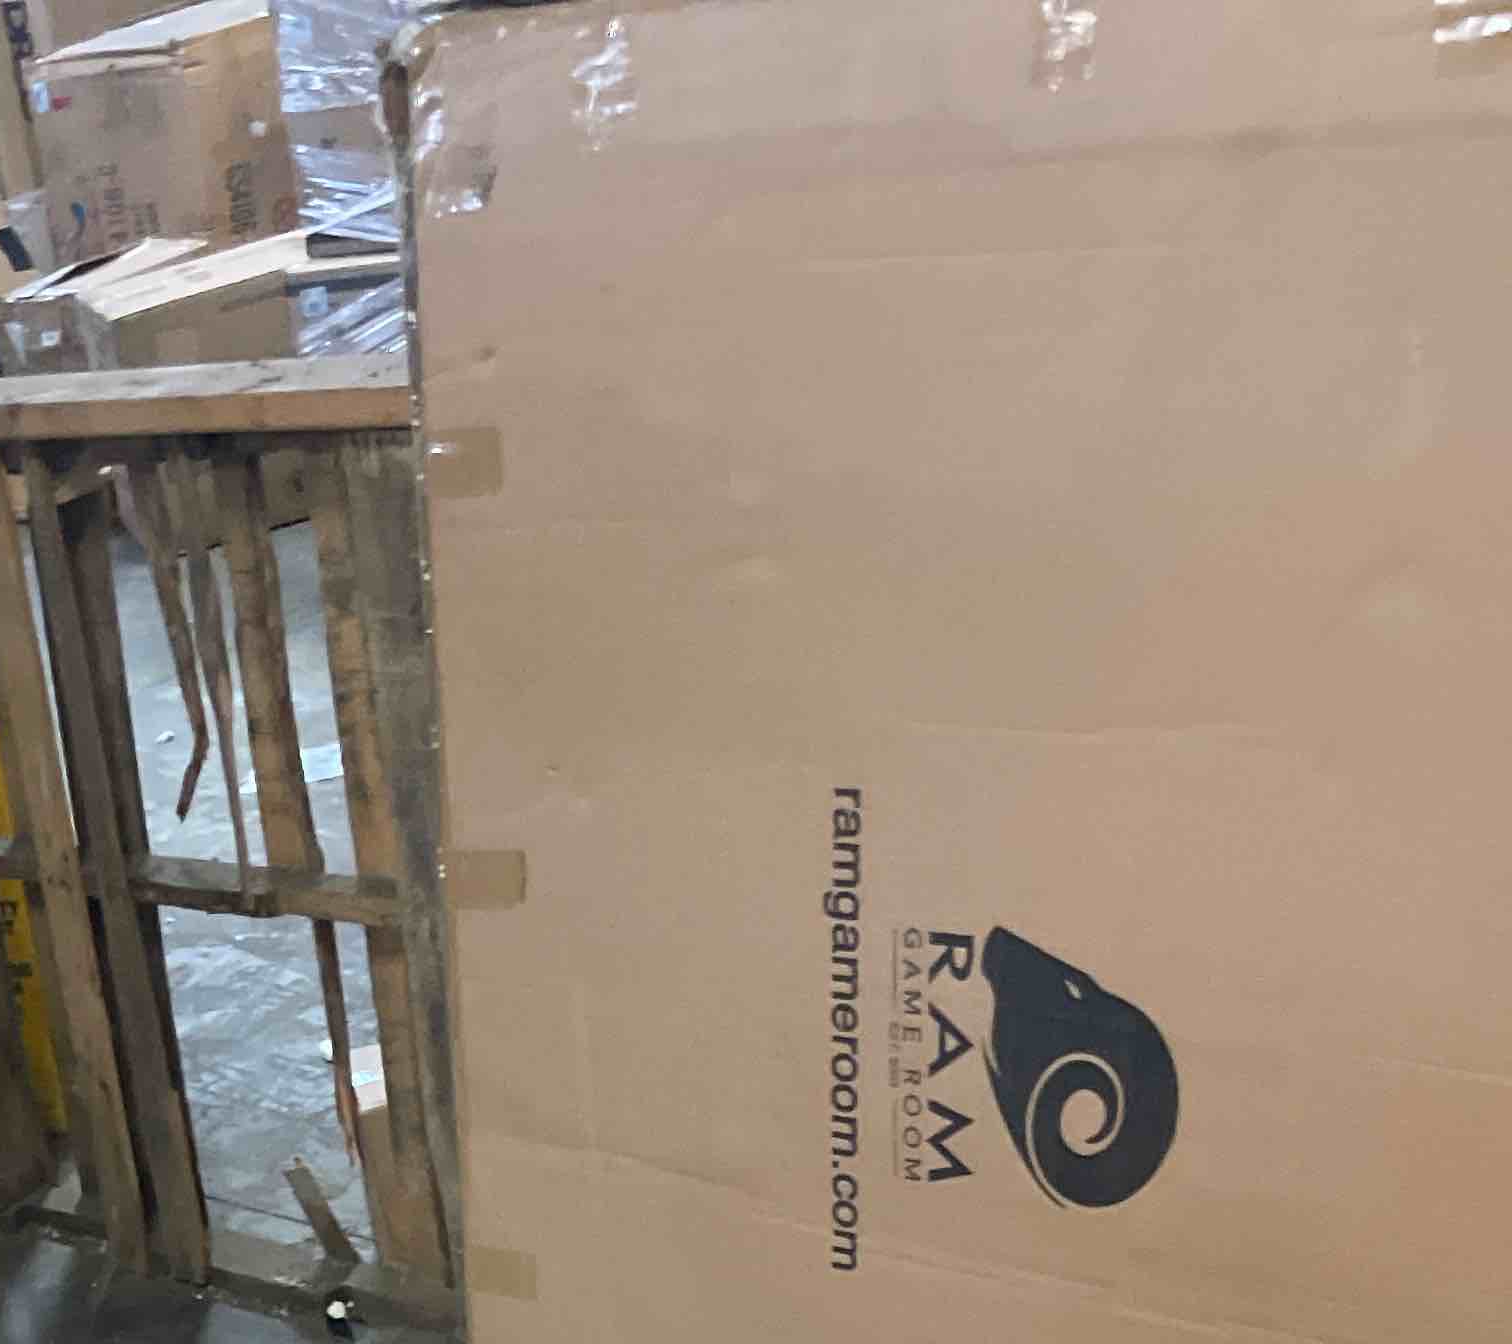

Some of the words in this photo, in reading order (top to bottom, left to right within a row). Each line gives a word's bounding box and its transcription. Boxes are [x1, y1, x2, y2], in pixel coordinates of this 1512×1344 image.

[822, 787, 862, 1271] ramgameroom.com
[903, 927, 923, 1043] GAME
[927, 931, 975, 1183] RAM
[903, 1069, 922, 1182] ROOM
